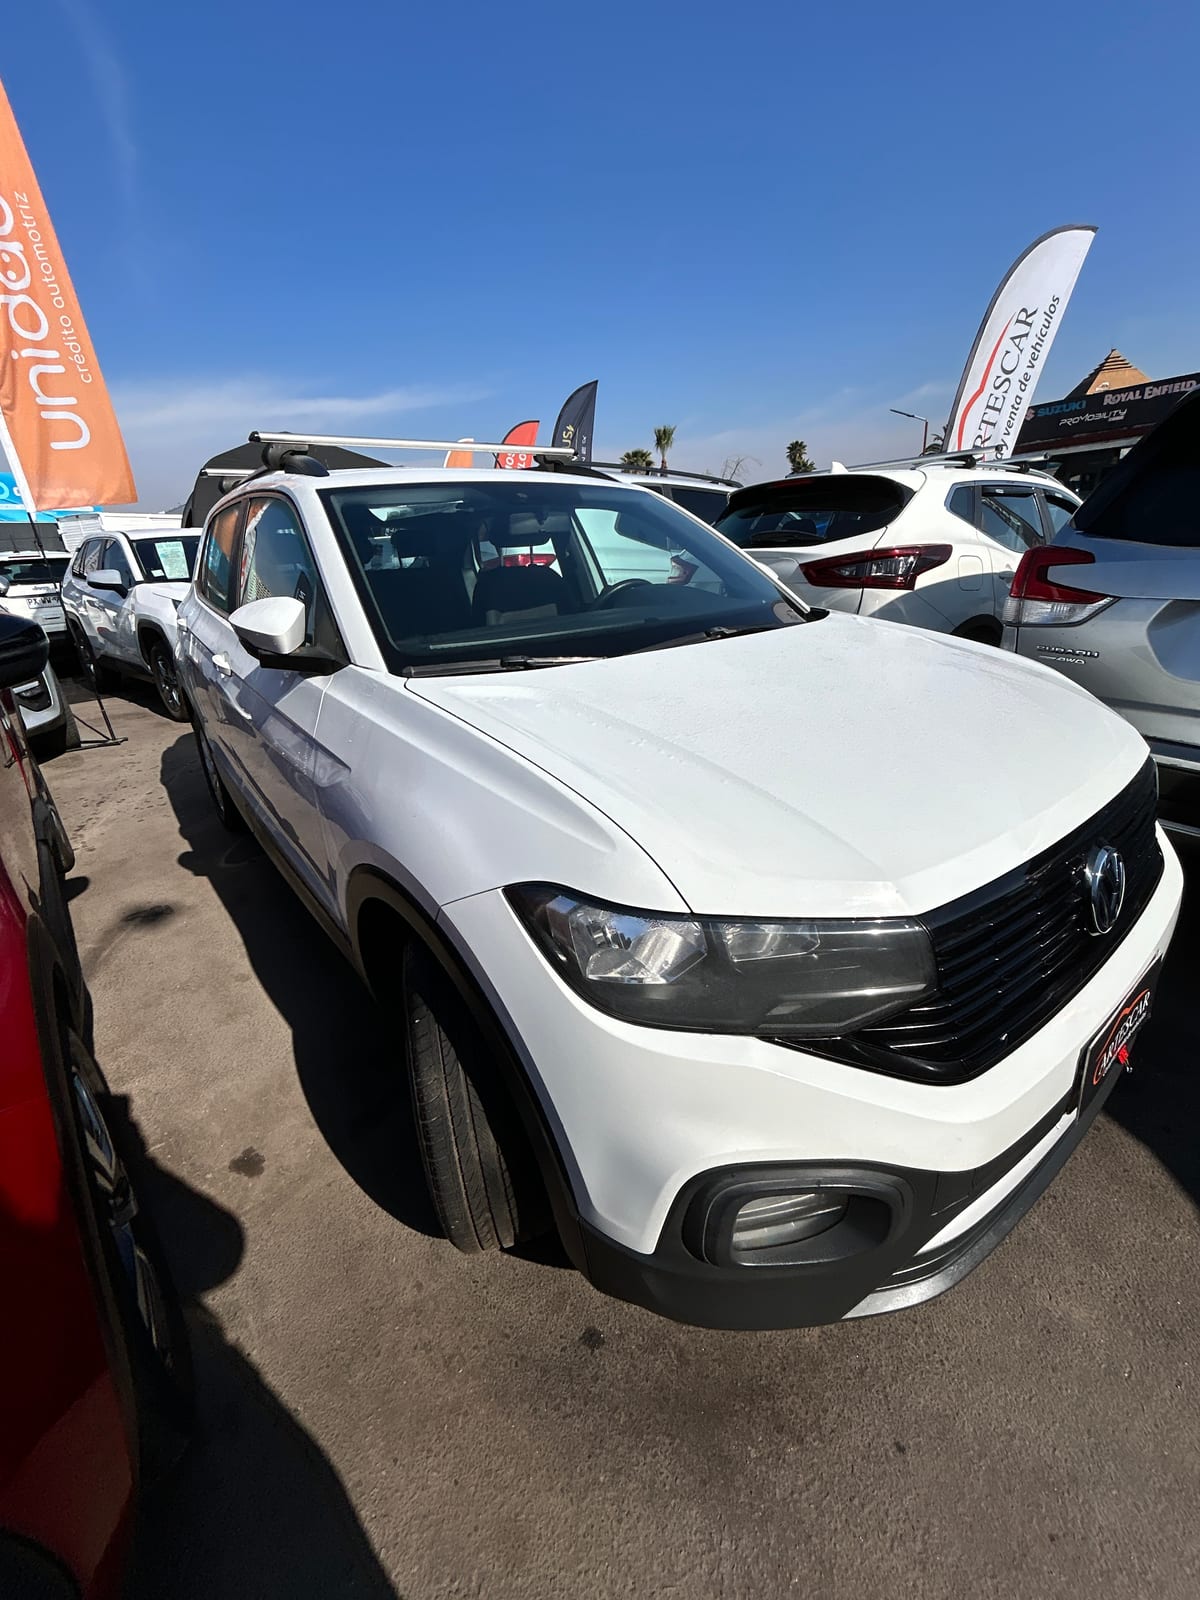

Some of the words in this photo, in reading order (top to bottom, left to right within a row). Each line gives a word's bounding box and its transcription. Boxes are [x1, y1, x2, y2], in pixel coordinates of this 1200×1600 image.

[14, 190, 67, 310] automotriz
[60, 315, 93, 384] crédito
[972, 307, 1039, 462] RTESCAR
[1003, 395, 1022, 437] venta
[1019, 372, 1032, 393] de
[1026, 295, 1061, 371] vehículos
[1103, 389, 1142, 406] ROYAL
[1143, 380, 1198, 400] ENFIELD
[1037, 400, 1087, 417] SUZUKI
